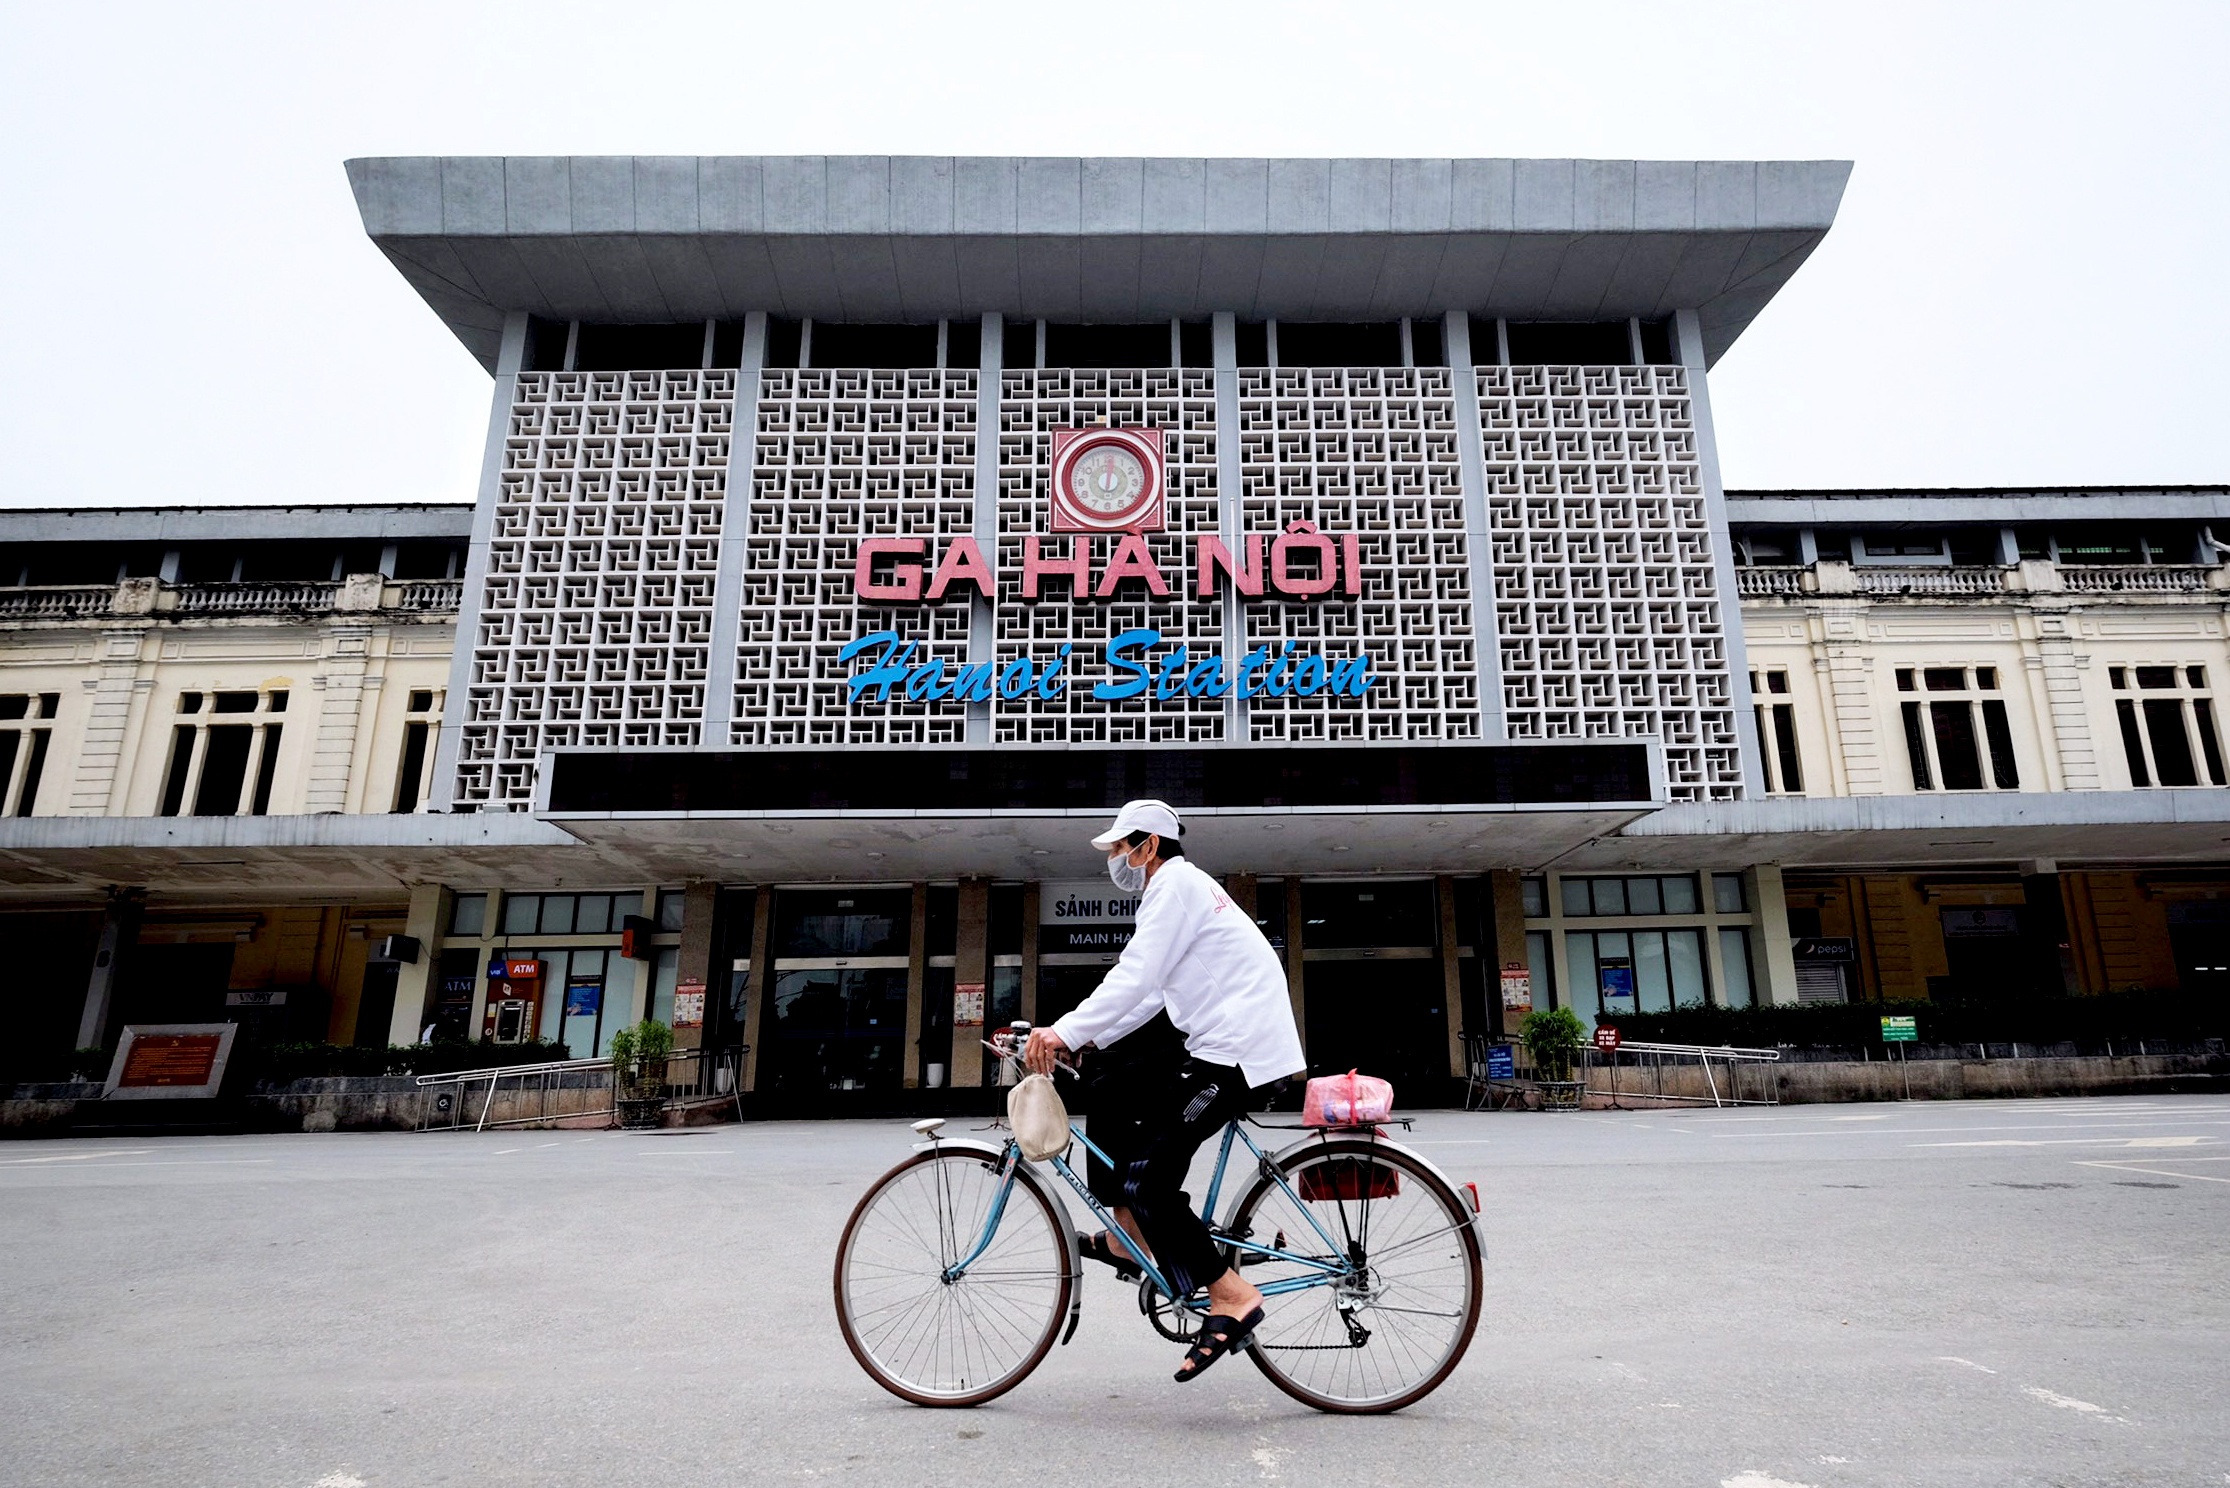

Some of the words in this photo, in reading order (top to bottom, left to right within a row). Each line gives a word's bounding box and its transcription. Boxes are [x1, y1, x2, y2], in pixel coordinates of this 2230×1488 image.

[1082, 466, 1092, 475] 10
[1128, 467, 1135, 475] 2
[1078, 478, 1085, 487] 9
[1132, 478, 1138, 487] 3
[1082, 490, 1088, 499] 8
[1092, 500, 1099, 508] 7
[1104, 502, 1111, 510] 6
[1117, 500, 1124, 508] 5
[855, 535, 997, 605] GA
[1022, 525, 1171, 604] HÀ
[1196, 519, 1363, 604] NỘI
[838, 630, 1073, 705] Hanoi
[1091, 628, 1378, 702] Station
[1055, 893, 1102, 917] SẢNH
[1108, 896, 1142, 917] CHÍ
[1069, 933, 1109, 945] MAIN
[1817, 944, 1847, 956] pepsi
[513, 964, 535, 974] ATM
[444, 980, 471, 992] ATM
